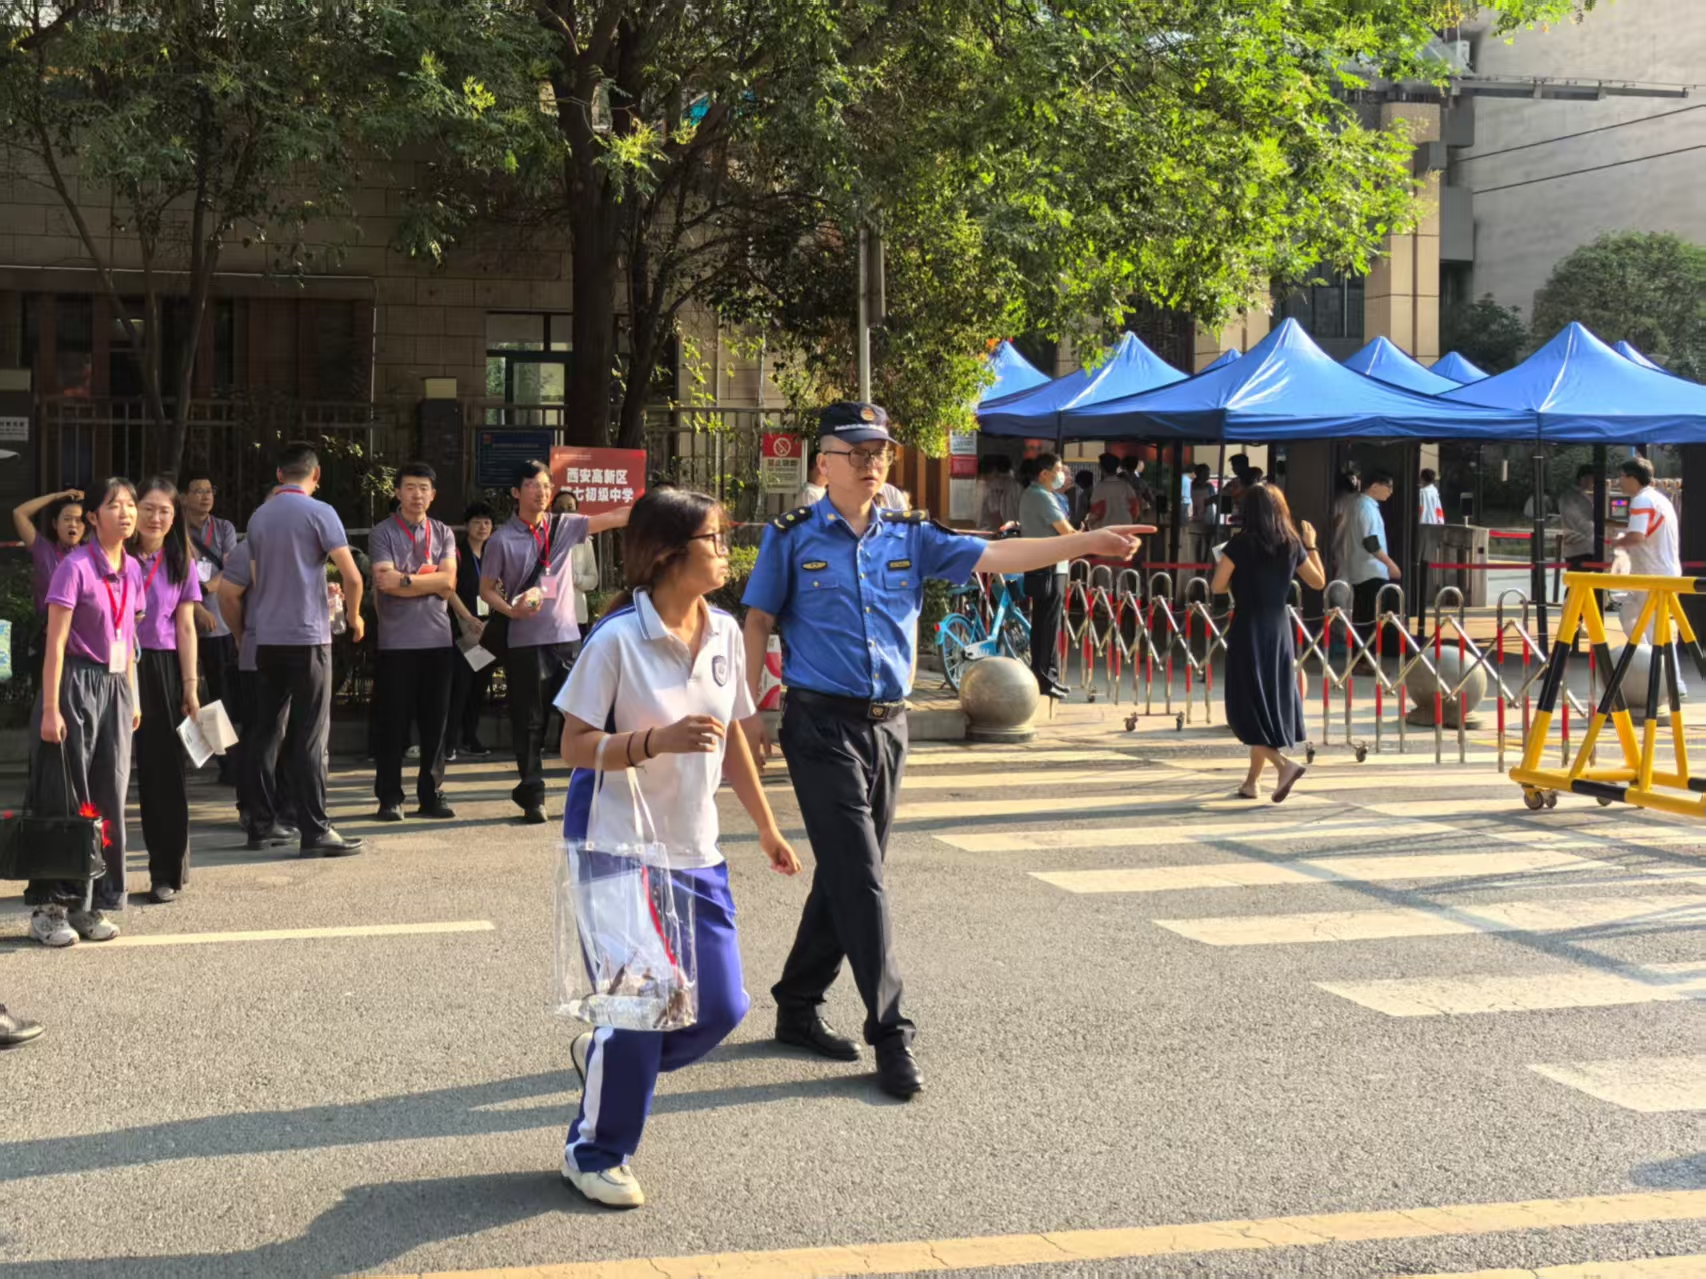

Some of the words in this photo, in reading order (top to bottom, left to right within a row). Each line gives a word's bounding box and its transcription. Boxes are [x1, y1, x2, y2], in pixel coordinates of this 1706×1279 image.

[567, 467, 628, 485] 西安高新区
